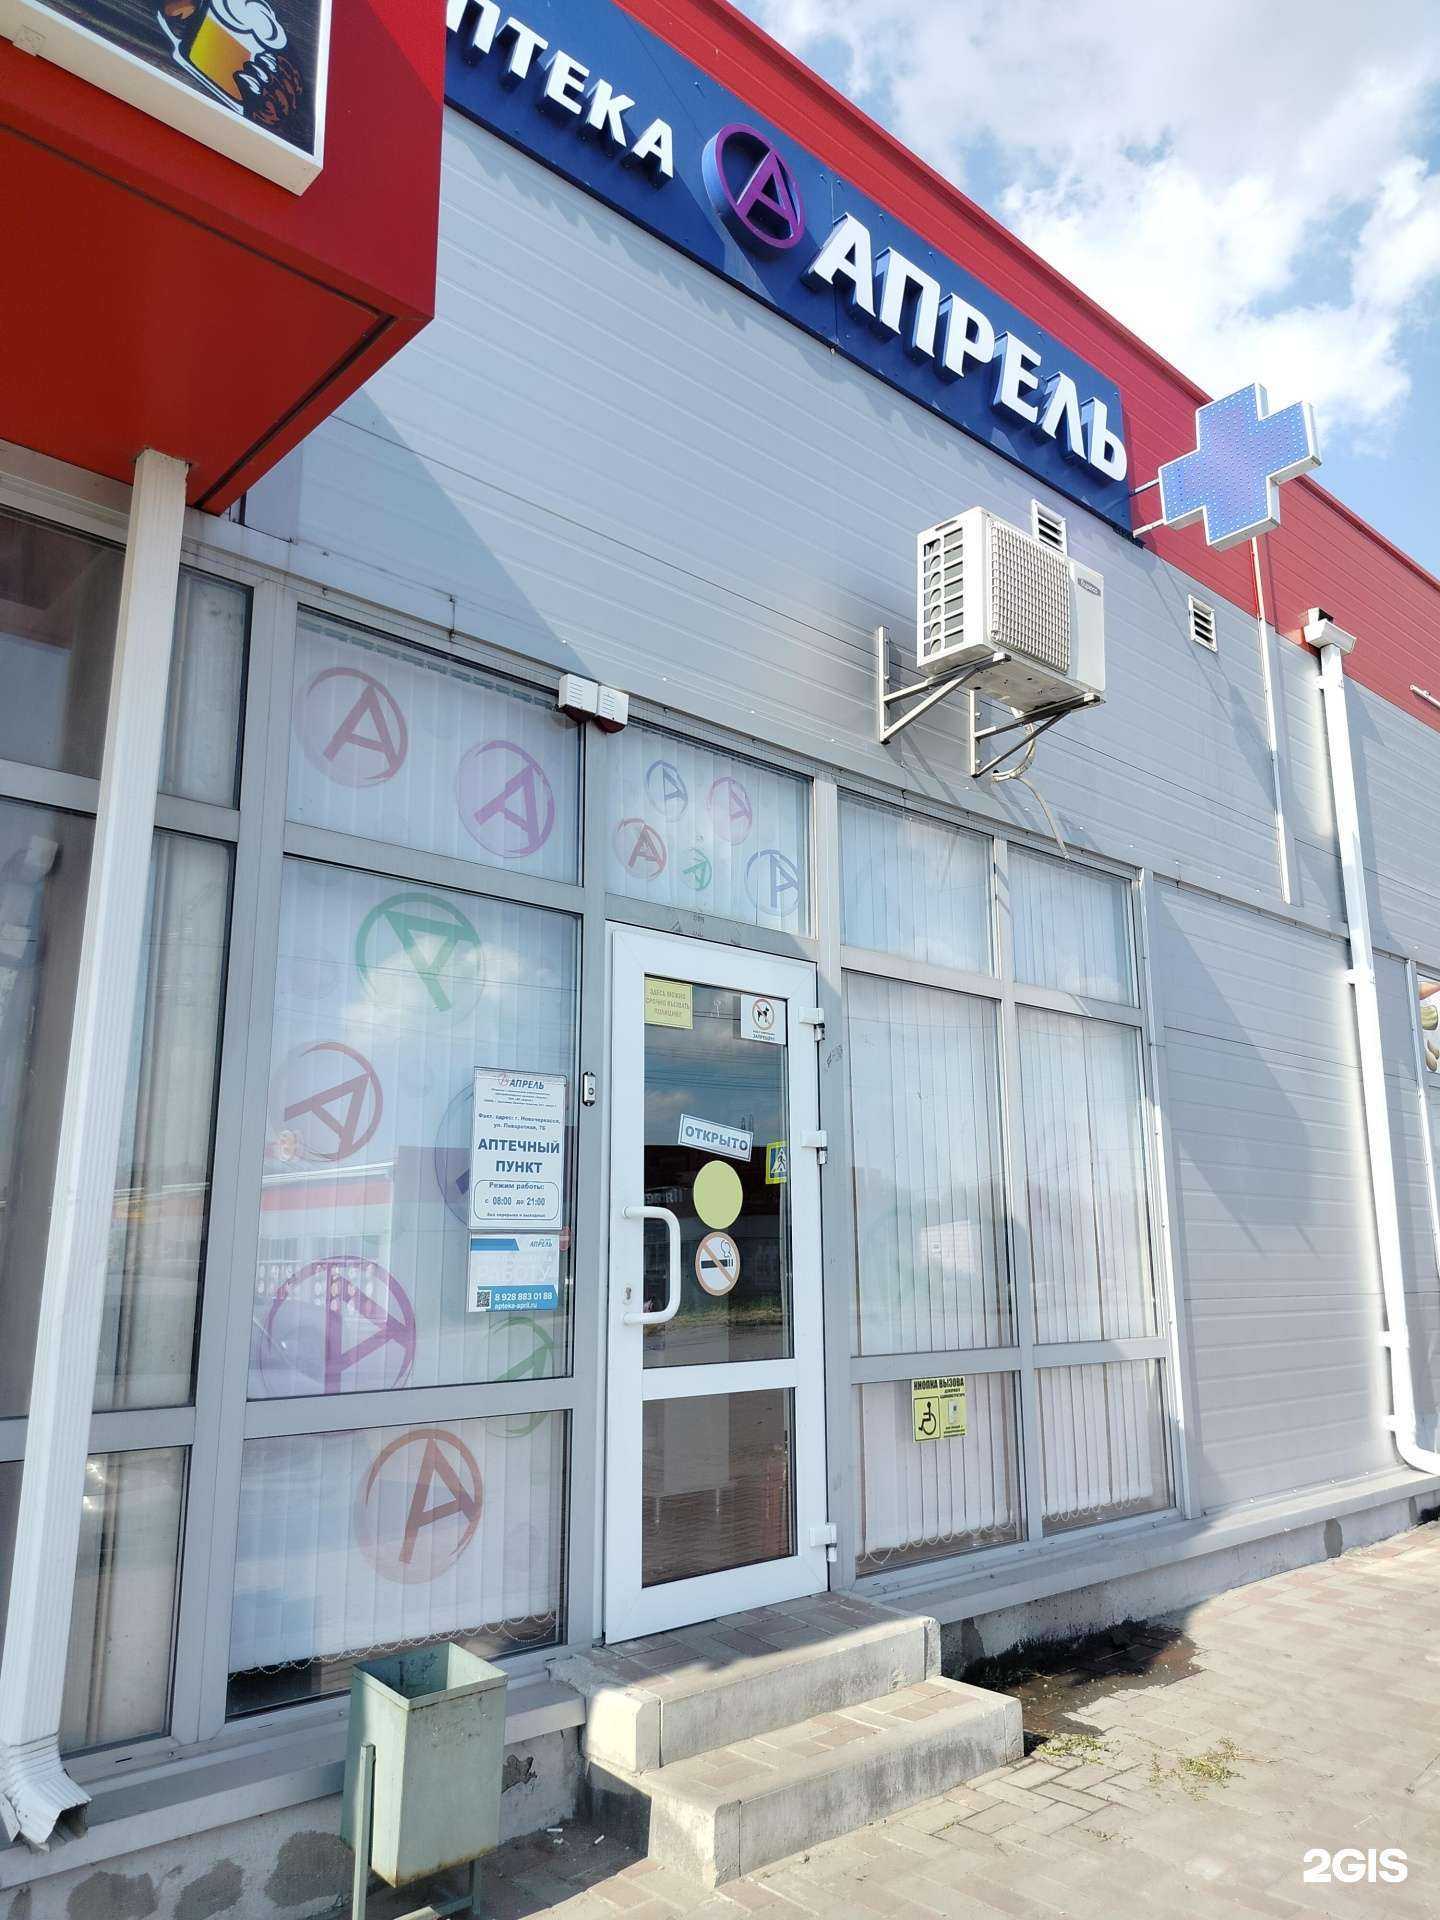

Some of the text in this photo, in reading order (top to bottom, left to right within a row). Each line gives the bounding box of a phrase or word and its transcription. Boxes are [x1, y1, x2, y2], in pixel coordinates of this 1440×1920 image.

[809, 212, 1128, 482] АПРЕЛЬ
[509, 1079, 545, 1090] АПРЕЛЬ
[685, 1125, 748, 1151] ОТКРЫТО
[478, 1138, 560, 1154] АПТЕЧНЫЙ
[495, 1160, 543, 1173] ПУНКТ
[489, 1181, 545, 1190] Режим работы:
[492, 1196, 512, 1206] 08:00
[526, 1197, 546, 1206] 21:00
[529, 1240, 553, 1248] АПРЕЛЬ
[939, 1378, 964, 1388] ВЫЗОВА
